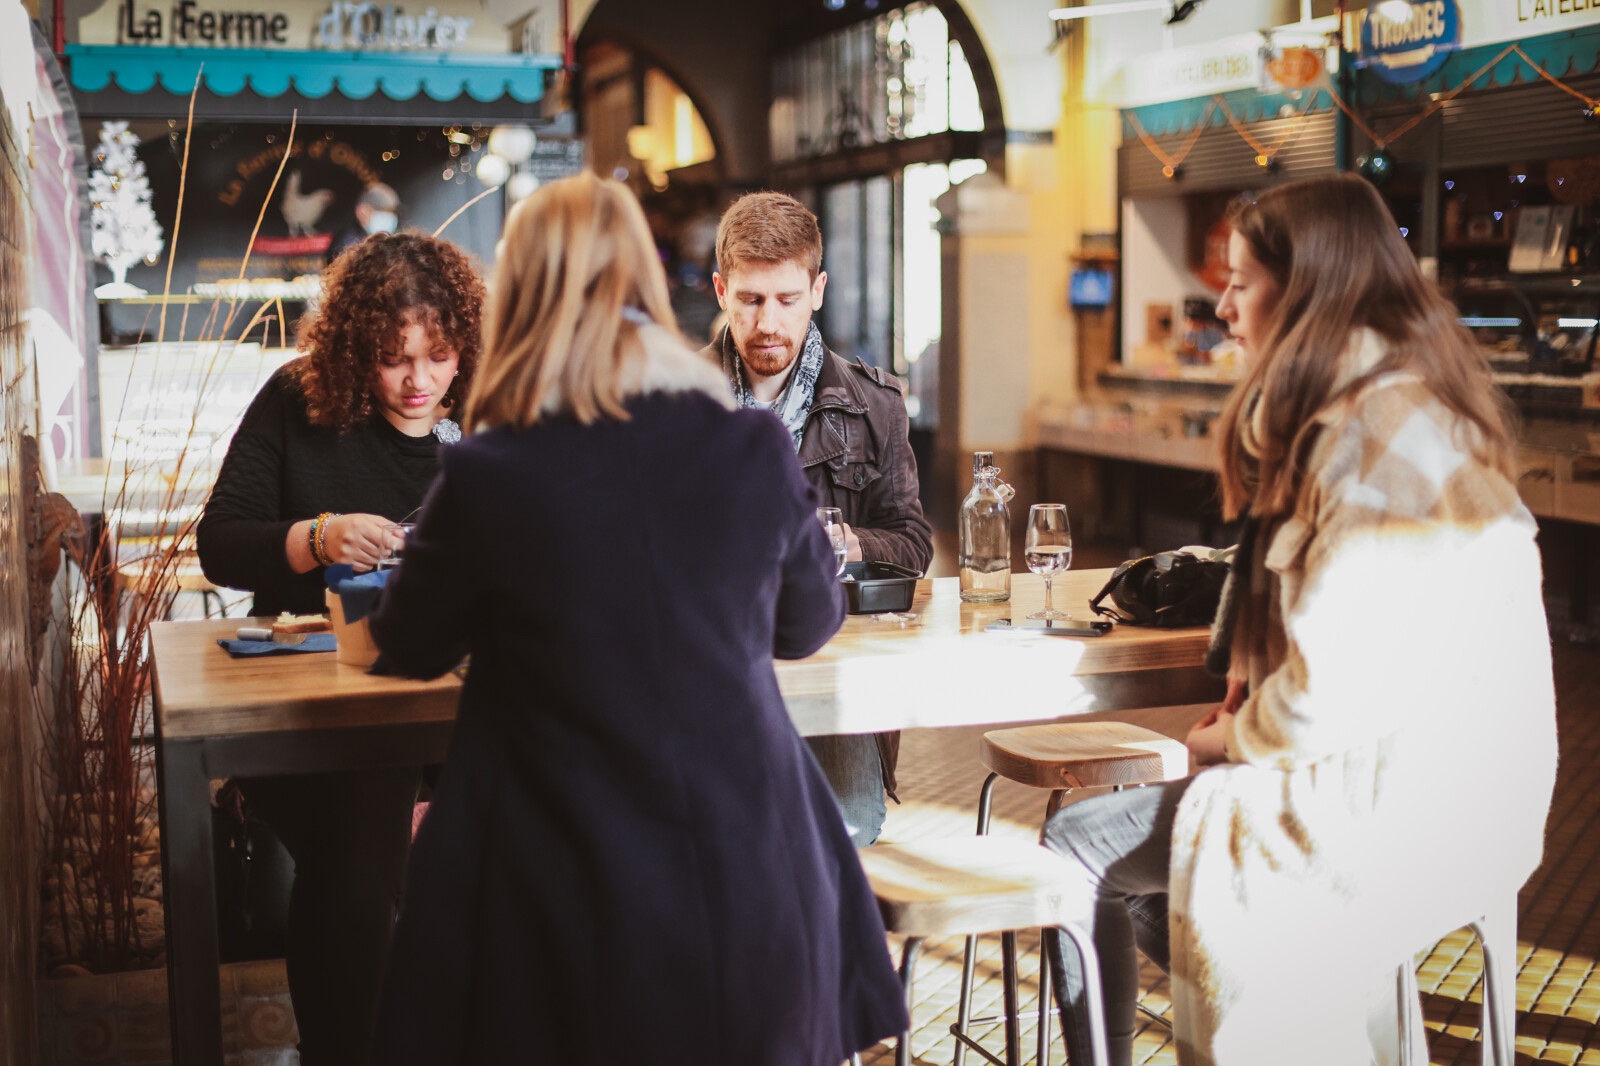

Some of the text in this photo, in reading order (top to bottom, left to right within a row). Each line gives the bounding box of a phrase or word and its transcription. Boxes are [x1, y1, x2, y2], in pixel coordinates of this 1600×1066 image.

[126, 0, 473, 46] La Ferme d'Olivier
